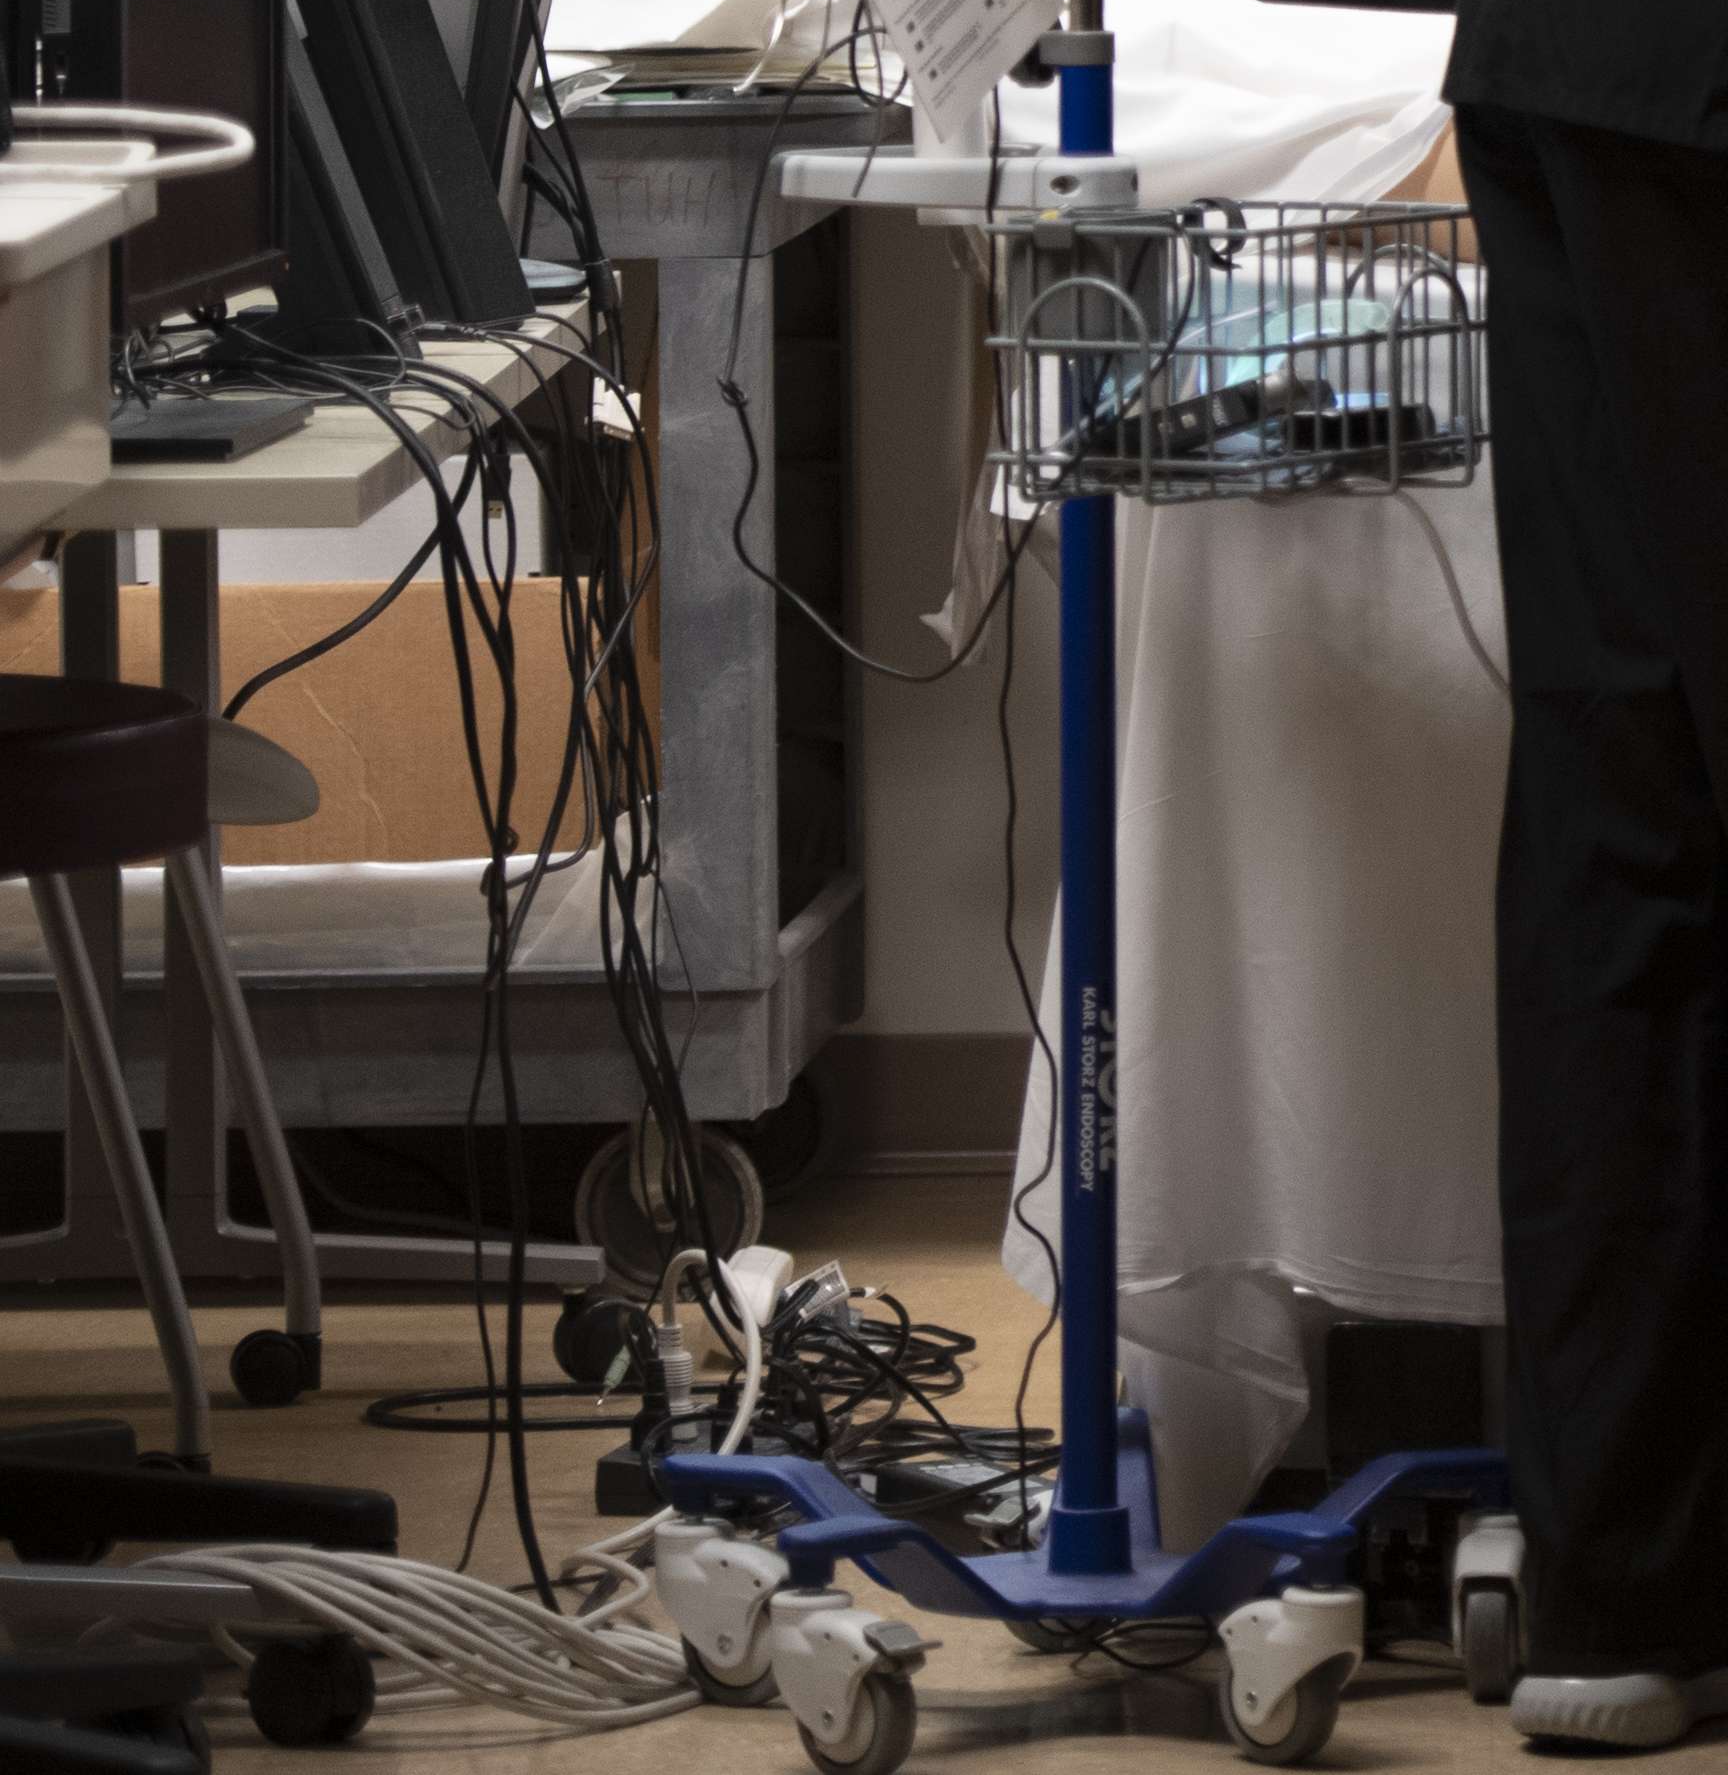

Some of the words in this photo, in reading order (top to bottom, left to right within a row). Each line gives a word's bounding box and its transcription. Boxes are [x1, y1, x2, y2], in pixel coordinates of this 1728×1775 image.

[1082, 987, 1097, 1030] KARL
[1080, 1035, 1097, 1088] STORZ
[1079, 1093, 1096, 1192] ENDOSCOPY
